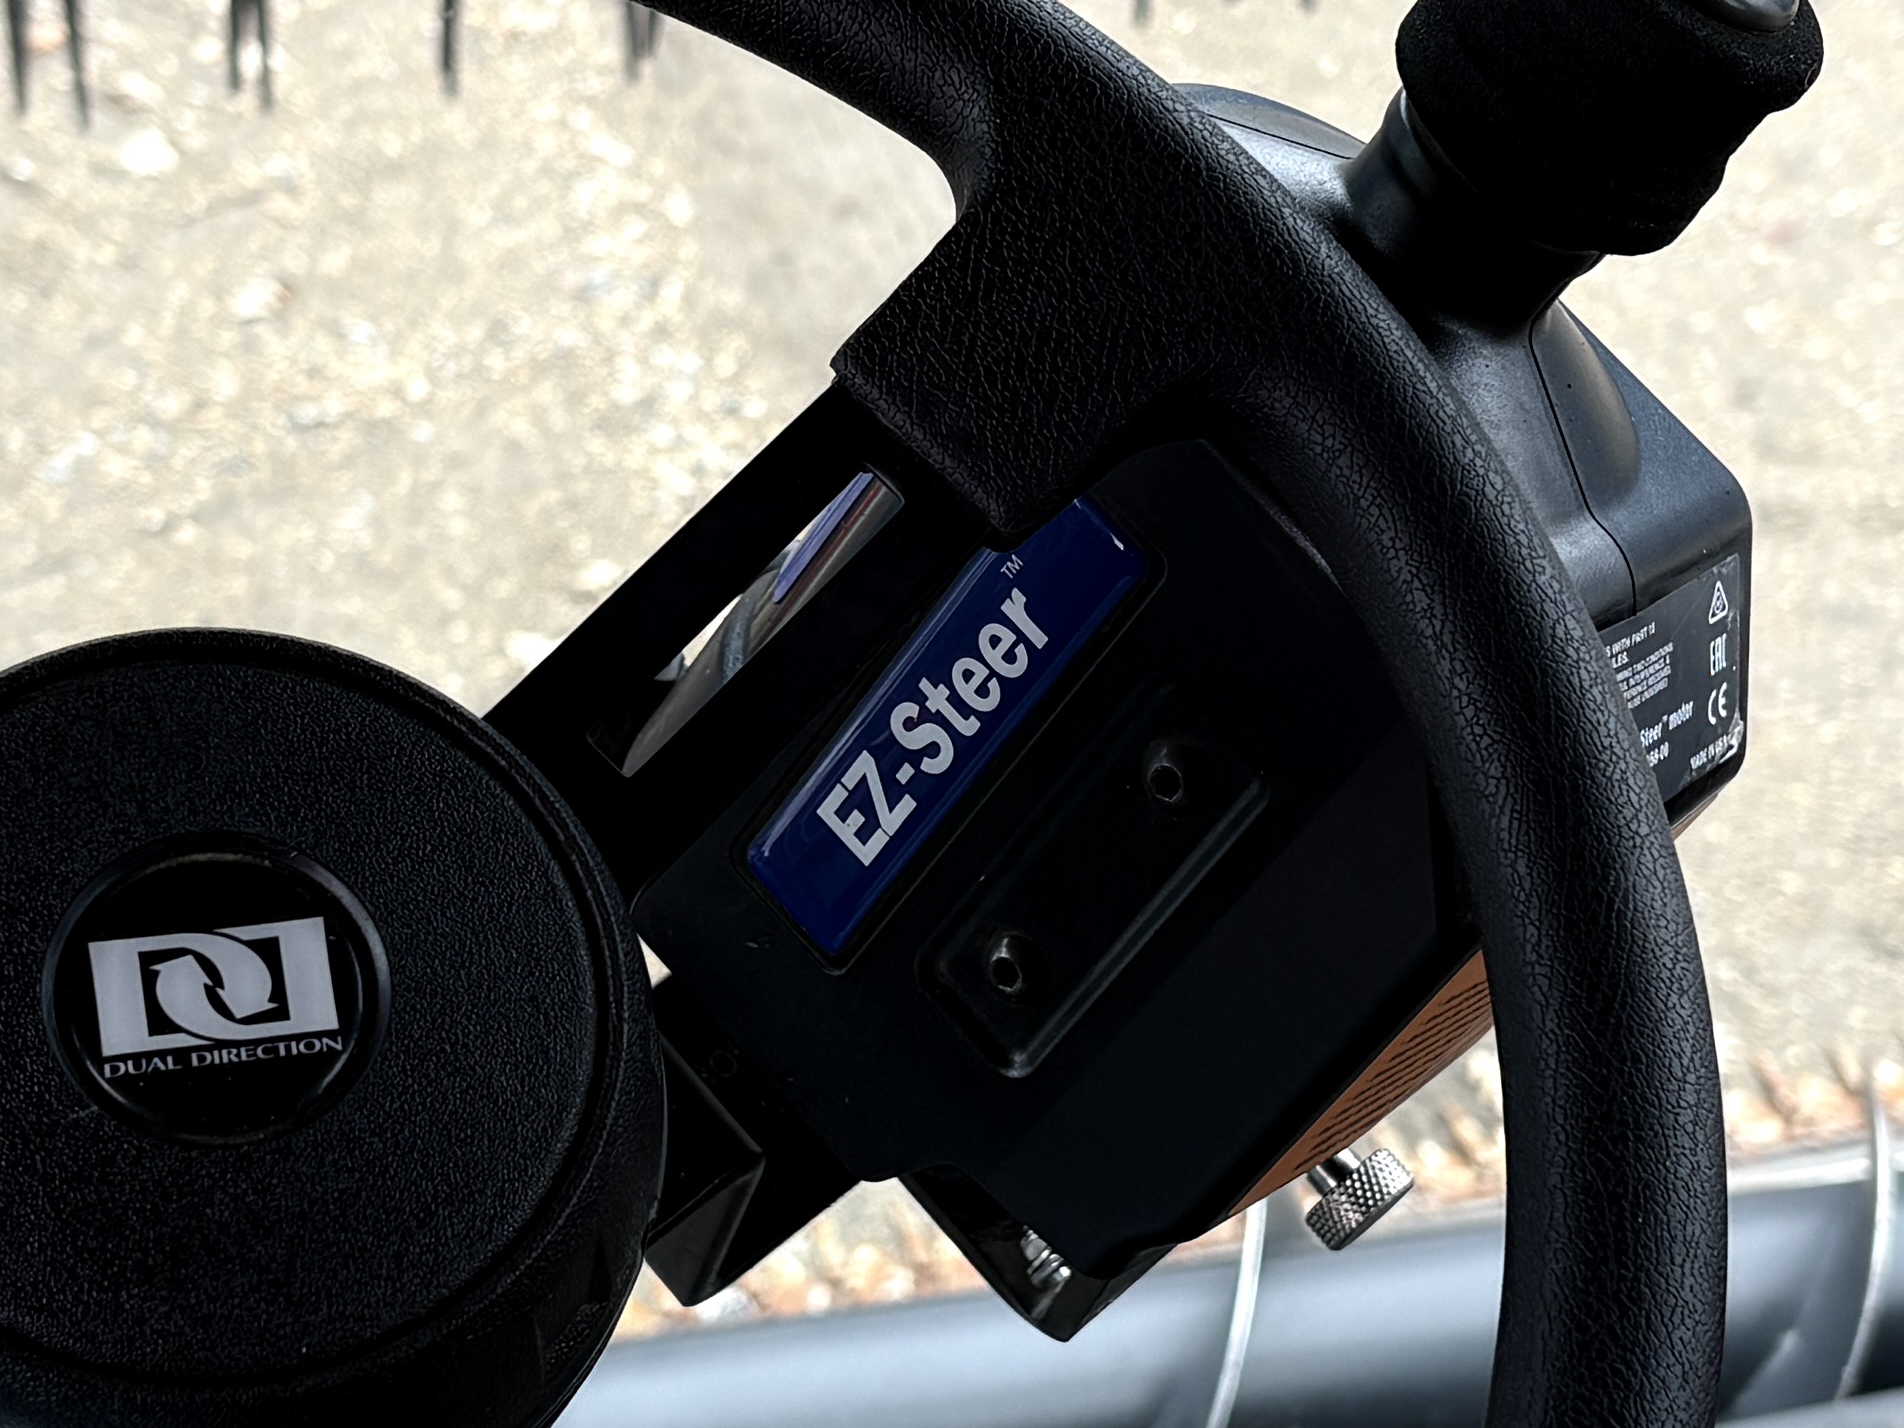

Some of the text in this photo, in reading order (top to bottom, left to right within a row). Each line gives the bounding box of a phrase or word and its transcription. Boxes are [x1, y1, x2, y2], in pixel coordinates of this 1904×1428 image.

[1668, 700, 1694, 731] motor
[102, 1035, 343, 1080] DUAL DIRECTION
